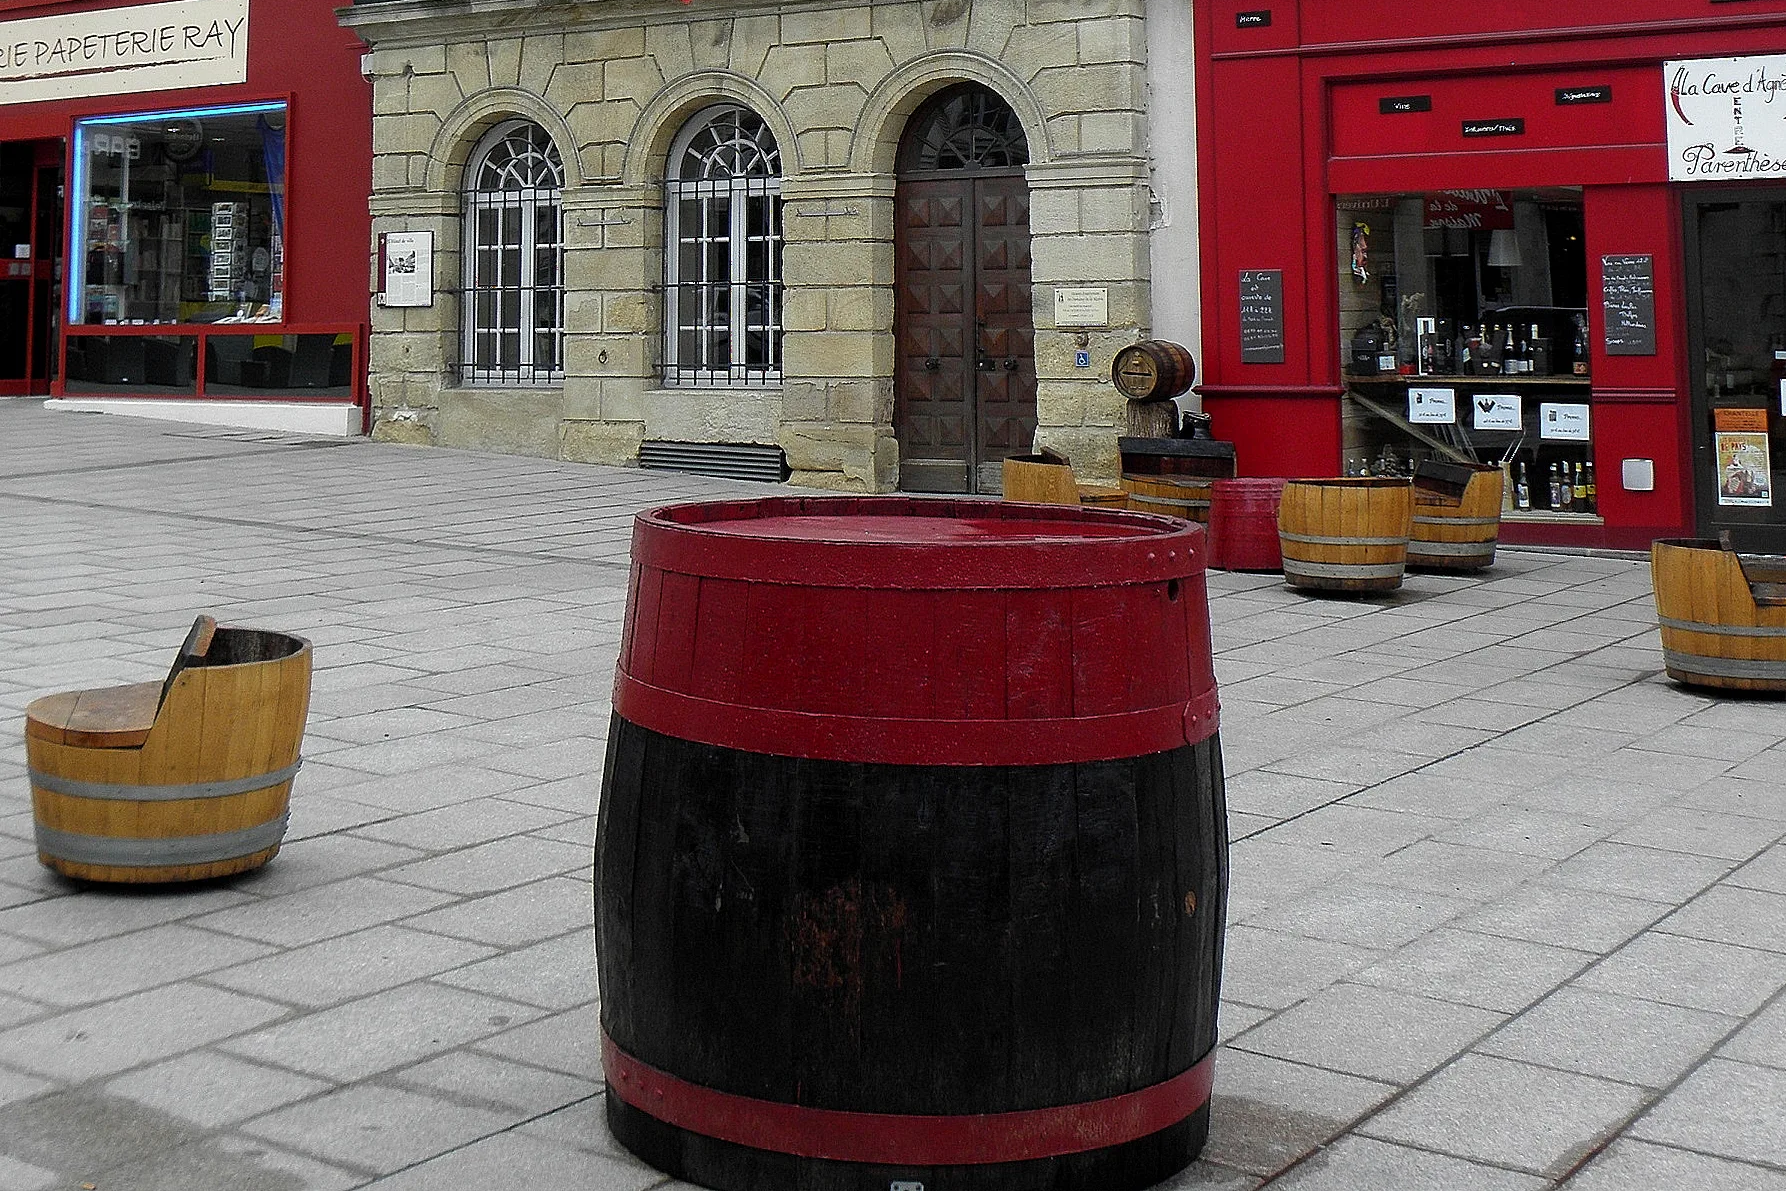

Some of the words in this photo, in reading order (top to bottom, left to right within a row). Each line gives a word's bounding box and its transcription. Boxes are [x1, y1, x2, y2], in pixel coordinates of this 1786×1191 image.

[34, 25, 176, 64] PAPETERIE
[182, 17, 245, 59] RAY
[1702, 73, 1740, 95] Cave
[1733, 96, 1744, 146] ENTRE
